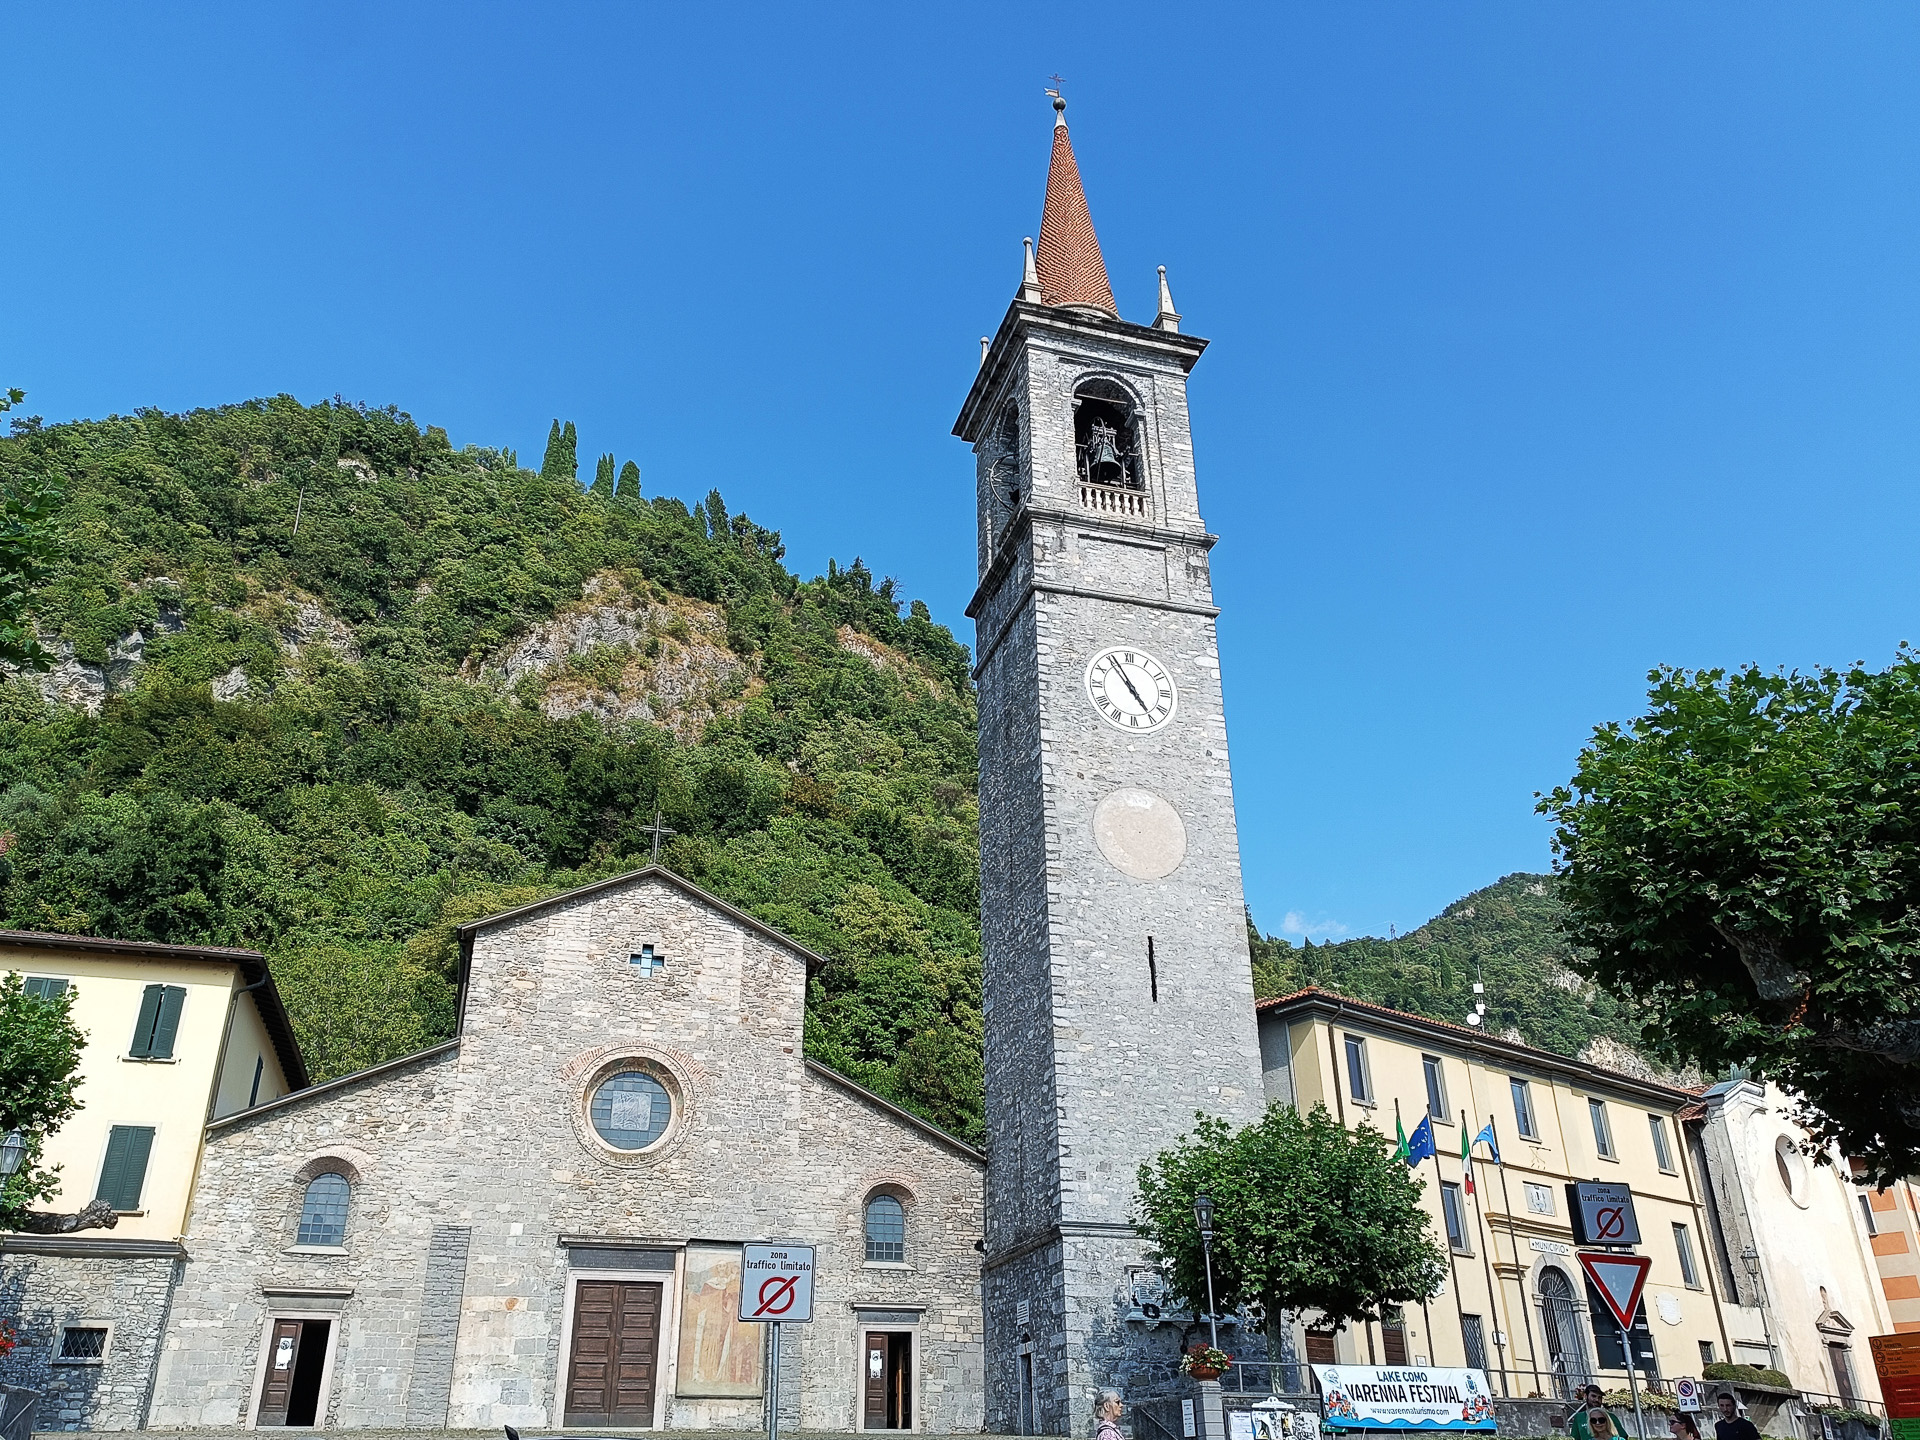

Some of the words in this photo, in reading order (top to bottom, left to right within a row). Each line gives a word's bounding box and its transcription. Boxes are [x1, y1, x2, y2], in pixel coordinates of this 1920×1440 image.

[1124, 652, 1134, 663] XII
[1095, 664, 1107, 674] X
[1143, 659, 1149, 668] I
[1153, 672, 1165, 681] II
[1091, 678, 1103, 688] IX
[1159, 689, 1171, 698] III
[1110, 708, 1122, 722] VII
[1156, 704, 1168, 716] IV
[1130, 715, 1139, 727] VI
[1147, 713, 1157, 725] V
[1581, 1194, 1604, 1203] traffico
[1606, 1194, 1630, 1204] limitato
[1534, 1241, 1566, 1254] MUNICIPIO
[770, 1251, 788, 1259] zona
[746, 1259, 777, 1270] traffico
[780, 1260, 811, 1271] limitato
[1376, 1370, 1402, 1382] LAKE
[1402, 1371, 1428, 1383] COMO
[1345, 1383, 1408, 1402] VARENNA
[1408, 1384, 1464, 1404] FESTIVAL
[1370, 1406, 1450, 1416] www.varennaturismo.com
